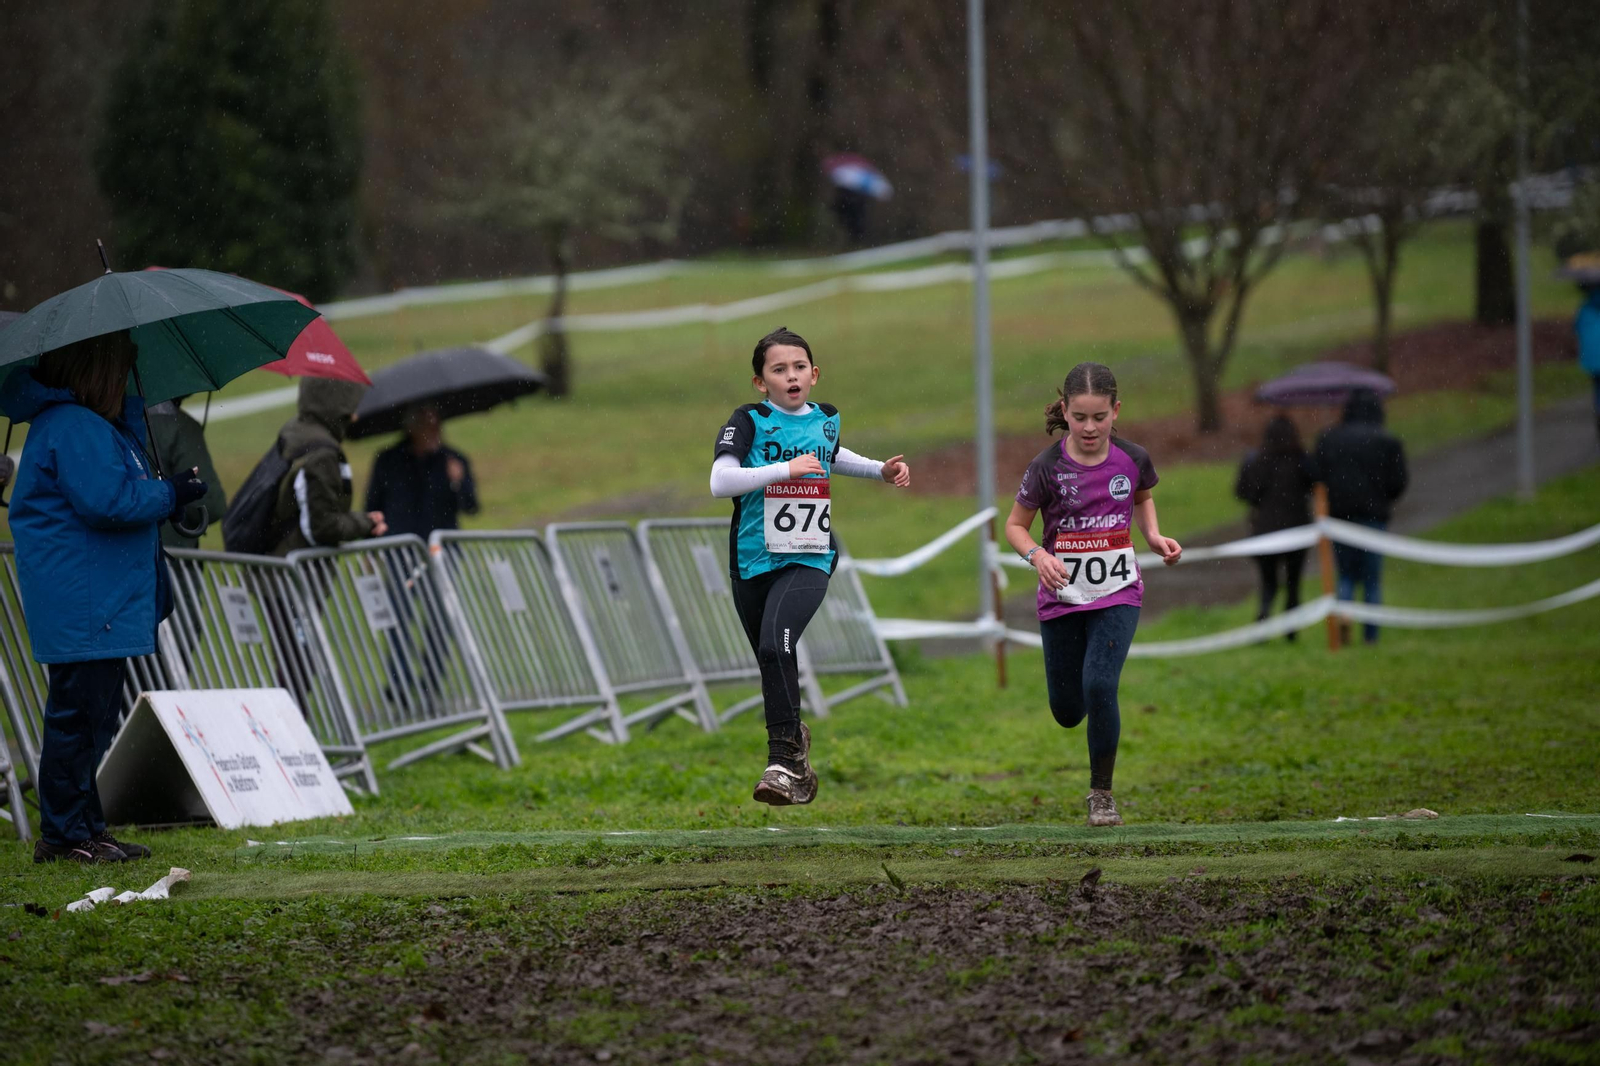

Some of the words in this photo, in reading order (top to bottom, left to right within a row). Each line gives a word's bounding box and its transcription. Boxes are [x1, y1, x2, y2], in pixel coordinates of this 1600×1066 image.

[766, 485, 819, 495] RIBADAVIA
[773, 503, 830, 533] 676
[1056, 539, 1110, 550] RIBADAVIA
[1111, 536, 1130, 546] 2026
[1063, 553, 1131, 585] 704
